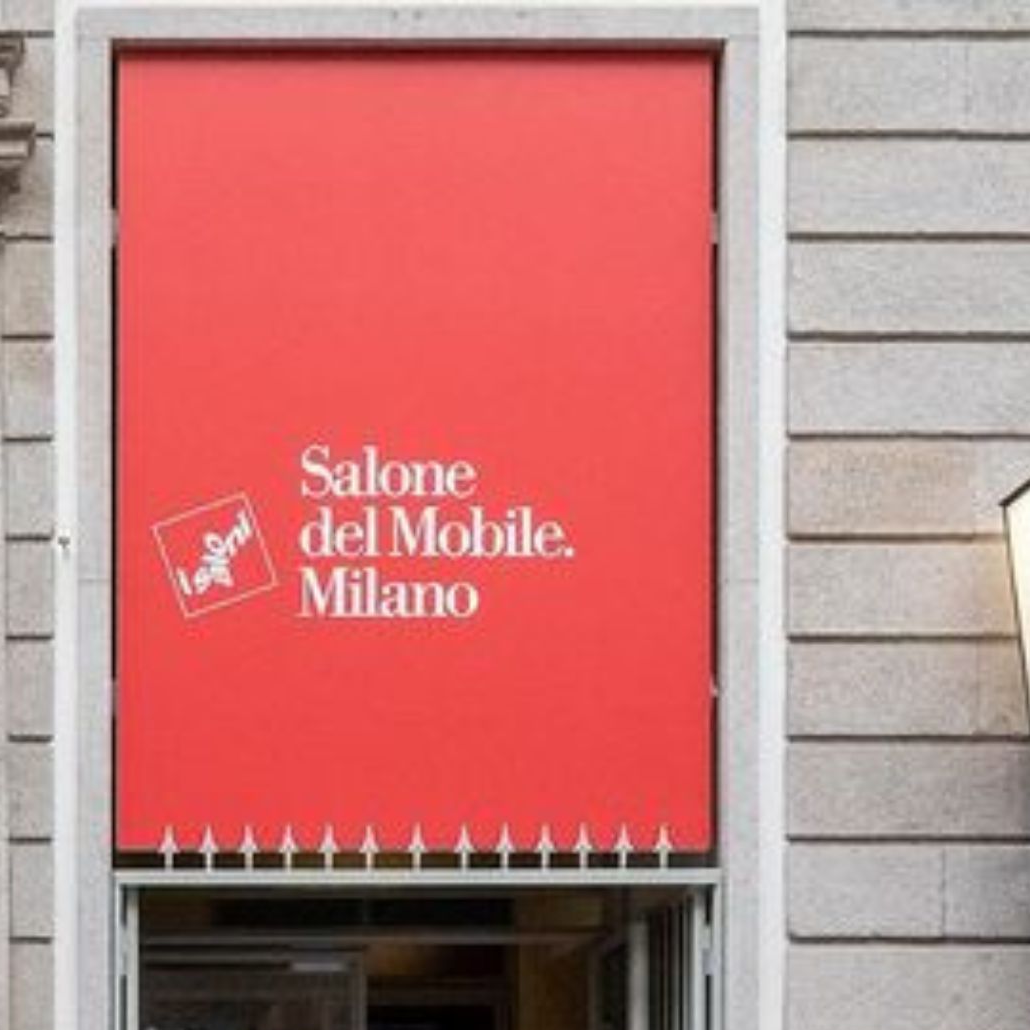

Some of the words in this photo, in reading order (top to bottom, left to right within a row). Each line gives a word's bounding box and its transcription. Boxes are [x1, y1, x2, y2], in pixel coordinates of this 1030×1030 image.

[300, 445, 477, 497] Salone
[300, 506, 379, 557] del
[390, 506, 575, 557] Mobile.
[299, 567, 479, 617] Milano
